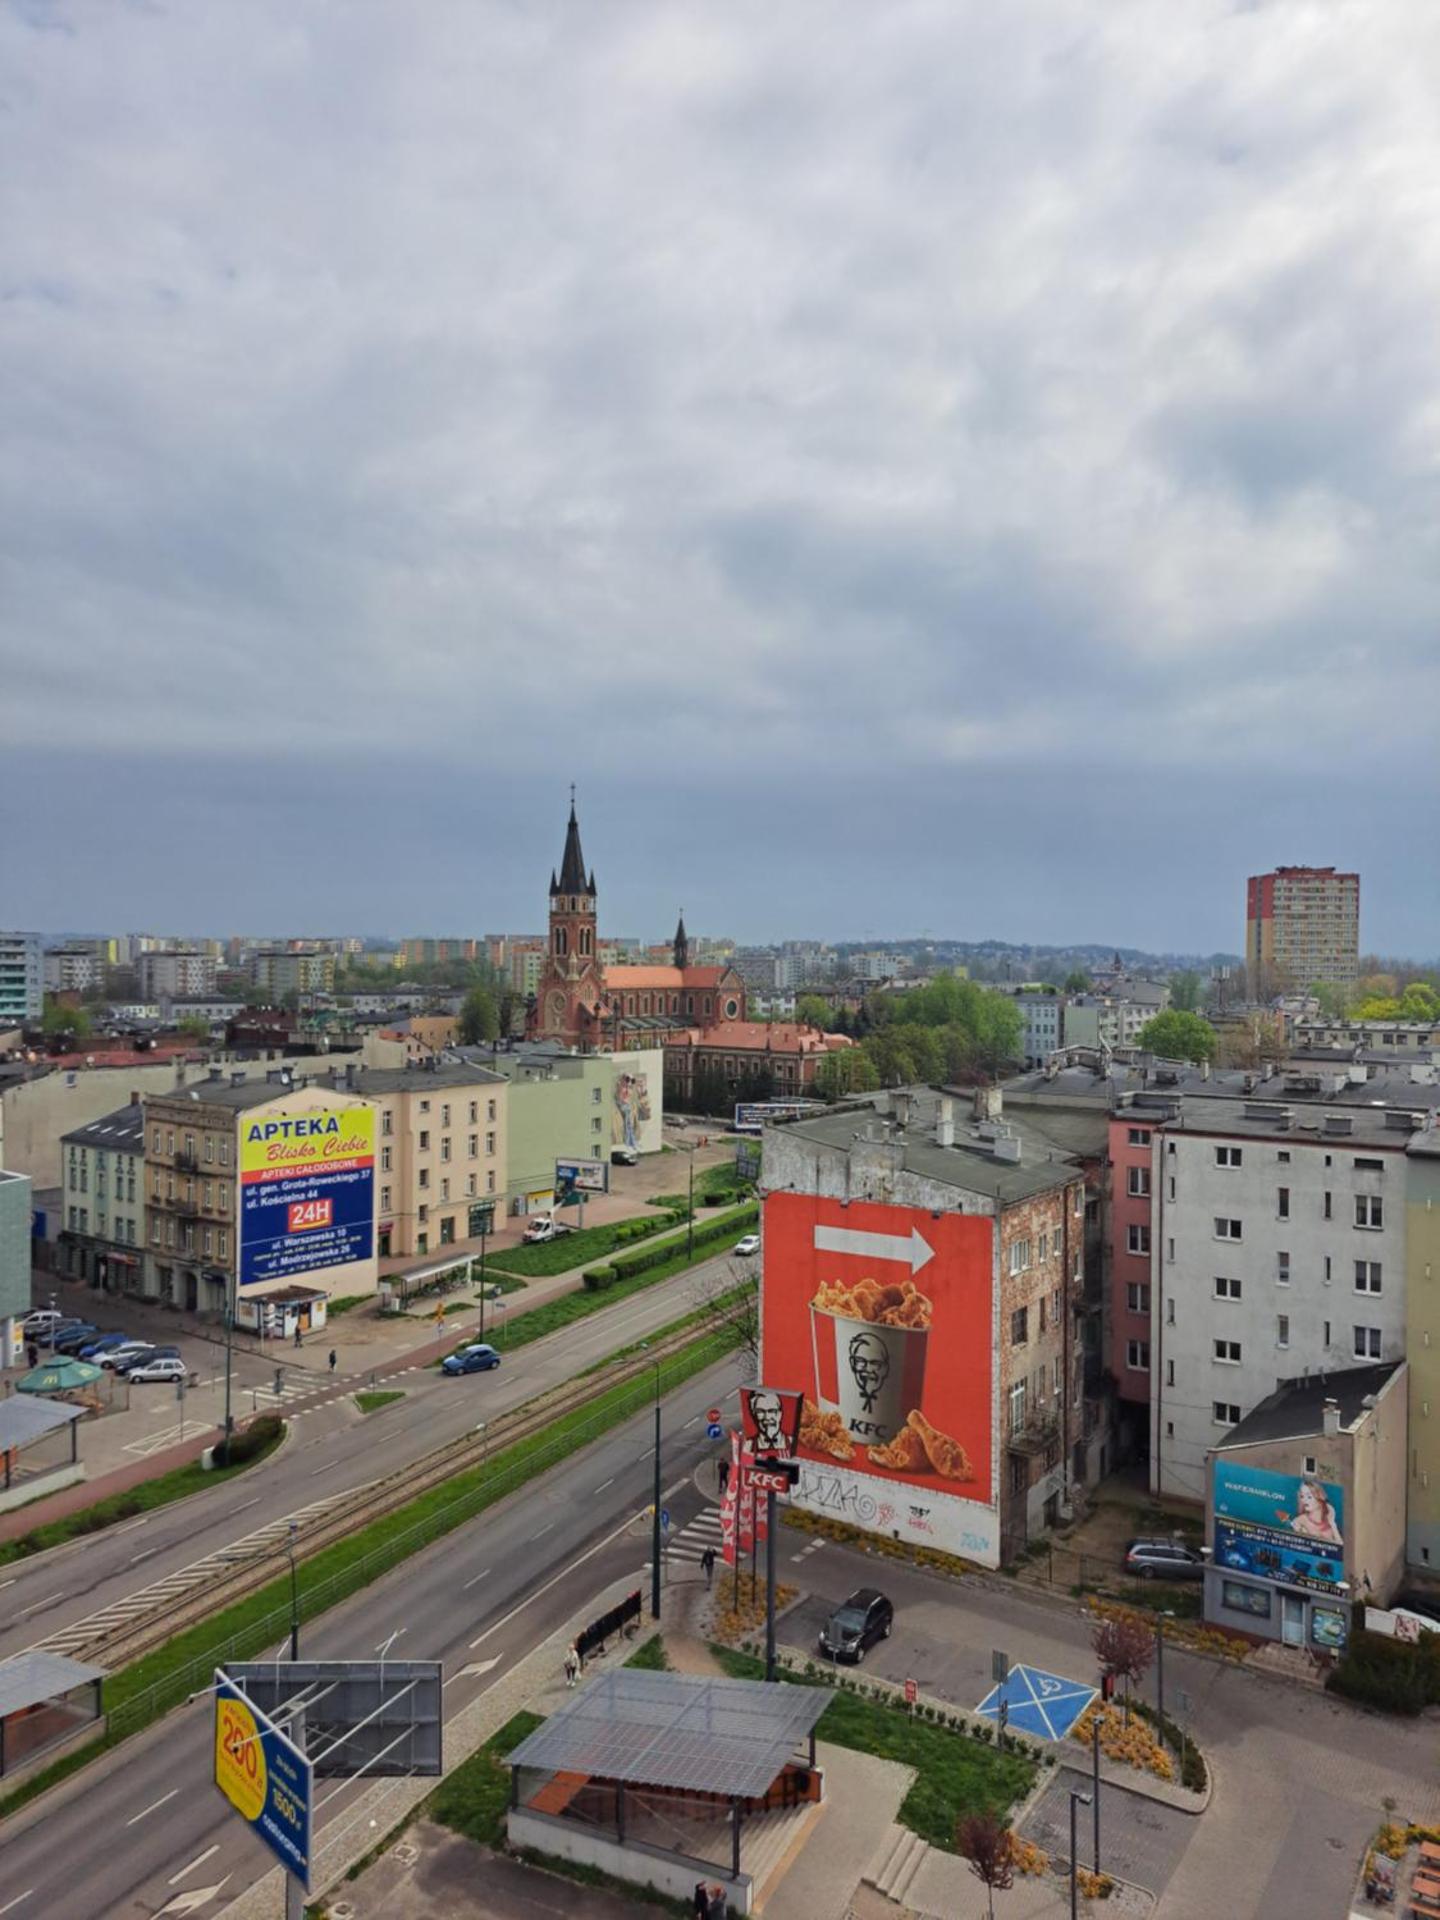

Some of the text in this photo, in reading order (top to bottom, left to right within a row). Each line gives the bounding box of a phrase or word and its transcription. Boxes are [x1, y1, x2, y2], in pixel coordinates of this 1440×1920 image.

[248, 1117, 338, 1142] APTEKA
[267, 1135, 368, 1161] Blisko Ciebie
[293, 1201, 329, 1223] 24H
[849, 1418, 888, 1439] KFC
[748, 1471, 785, 1490] KFC
